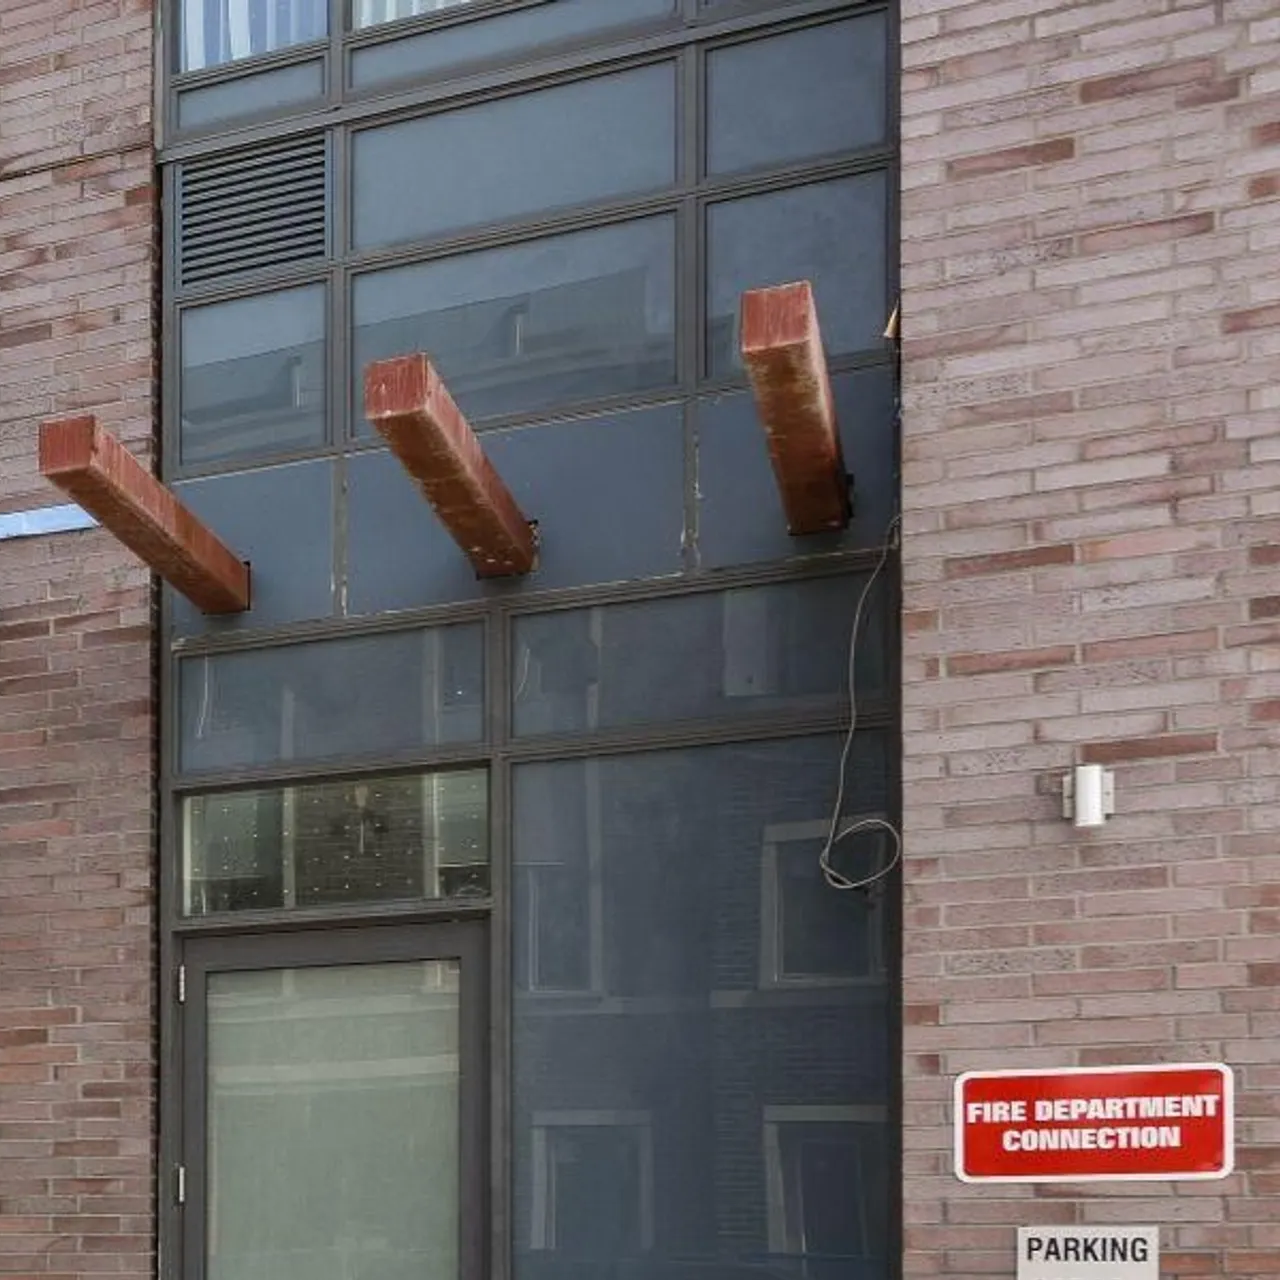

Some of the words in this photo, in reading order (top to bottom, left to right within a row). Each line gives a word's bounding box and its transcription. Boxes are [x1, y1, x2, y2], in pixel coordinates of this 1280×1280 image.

[966, 1100, 1027, 1124] FIRE
[1034, 1095, 1220, 1122] DEPARTMENT
[1002, 1126, 1181, 1151] CONNECTION
[1026, 1237, 1148, 1262] PARKING
